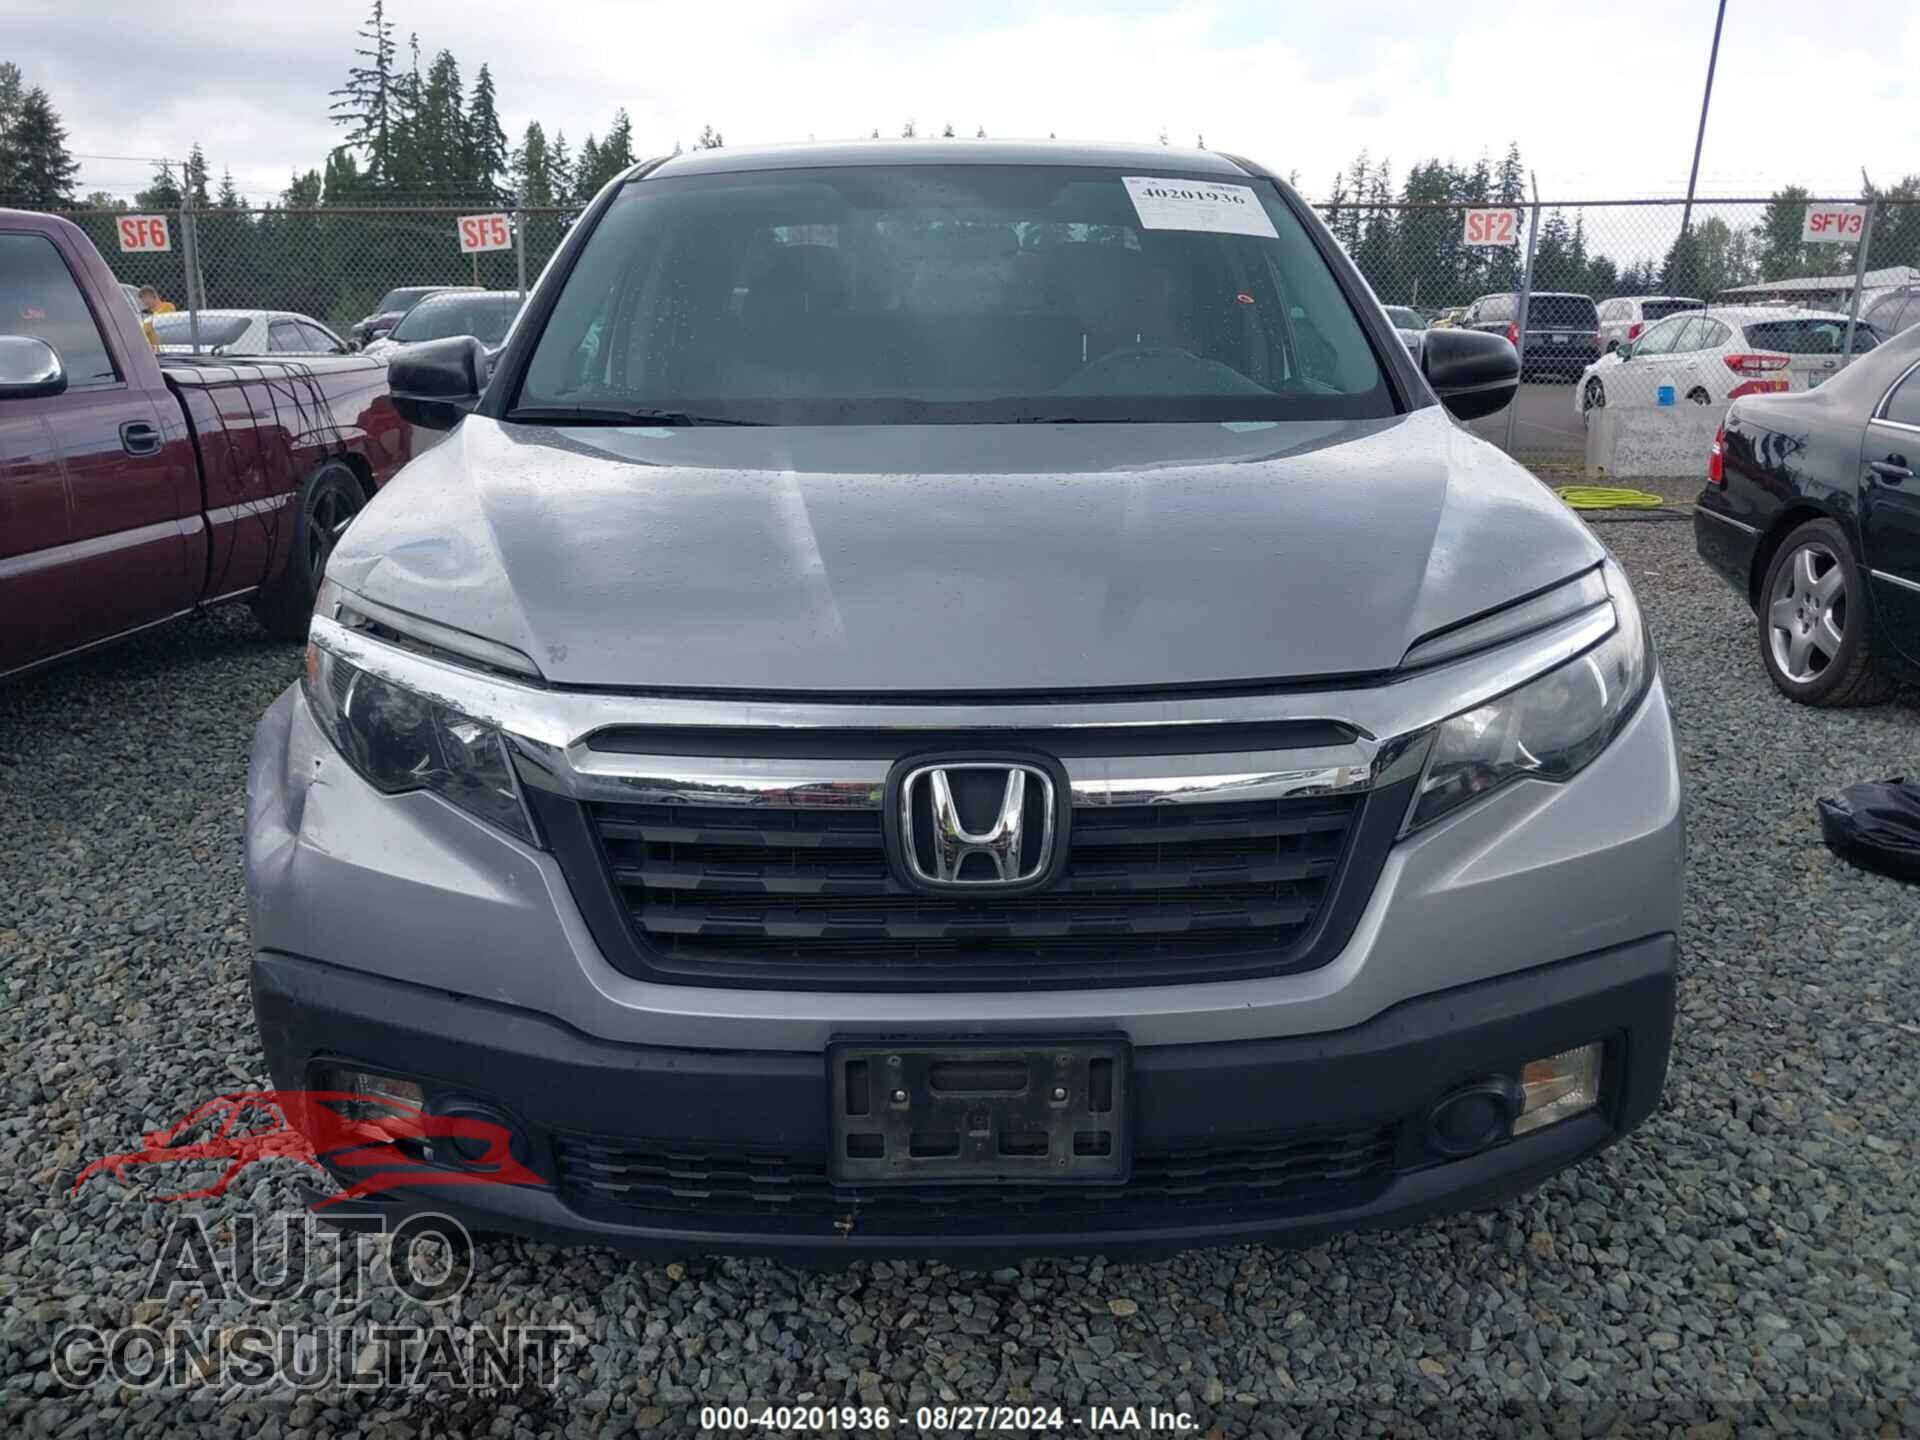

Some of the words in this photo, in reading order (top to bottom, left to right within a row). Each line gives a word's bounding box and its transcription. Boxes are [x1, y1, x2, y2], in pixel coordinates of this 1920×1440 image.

[1143, 188, 1246, 205] 40201936
[121, 219, 166, 248] SF6
[463, 217, 506, 248] SF5
[1468, 213, 1513, 241] SF2
[1810, 212, 1863, 233] SFV3
